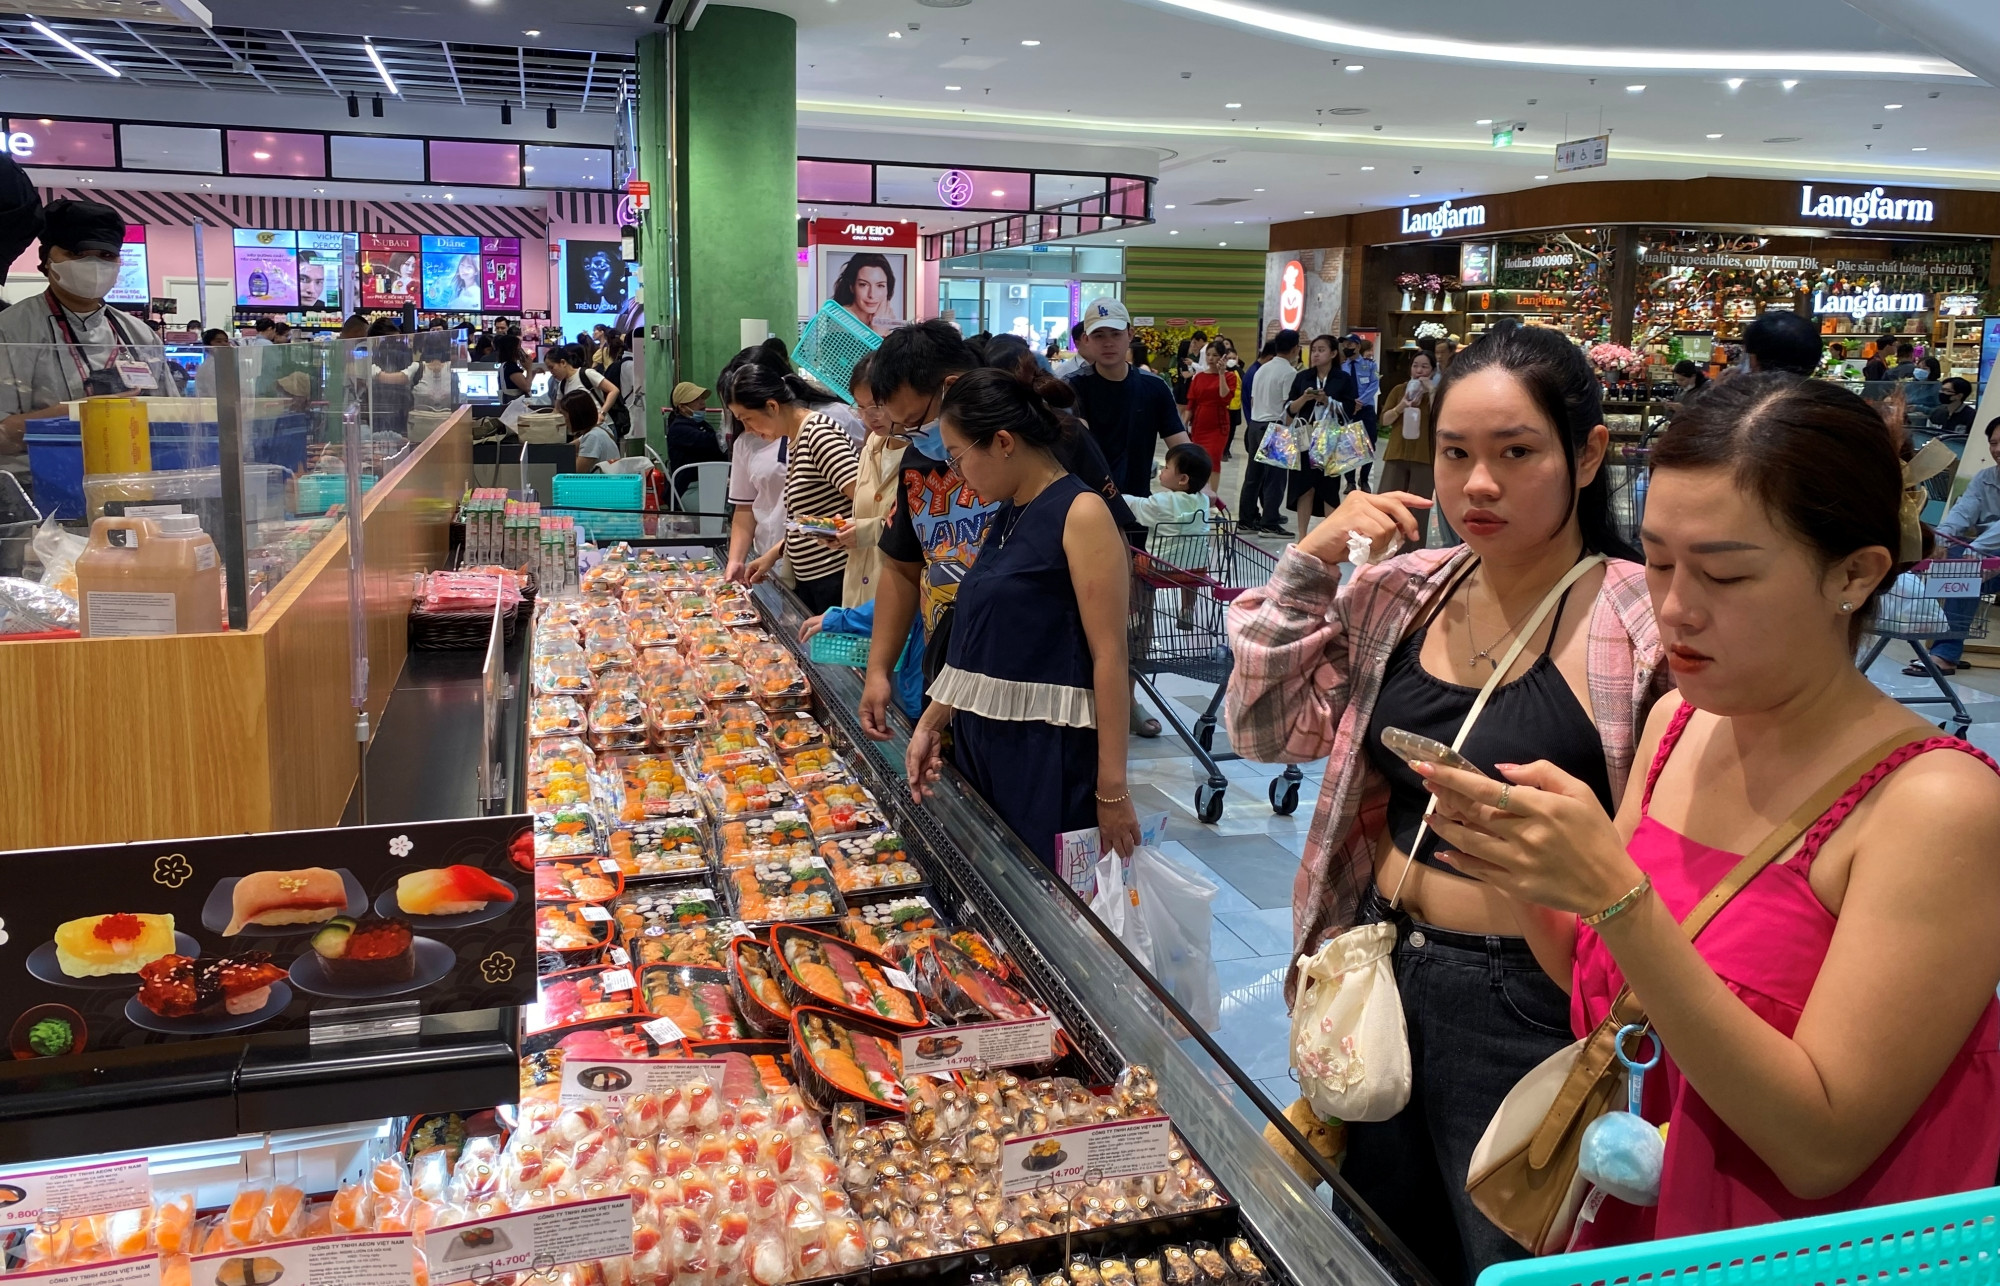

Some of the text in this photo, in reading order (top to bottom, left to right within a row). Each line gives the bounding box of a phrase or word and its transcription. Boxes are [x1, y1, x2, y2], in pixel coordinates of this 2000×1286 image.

[1801, 185, 1933, 226] Langfarm
[1401, 200, 1485, 237] Langfarm
[841, 223, 894, 236] SHISEIDO
[372, 239, 409, 247] TSUBAKI
[1504, 254, 1573, 268] Hotline 19009065
[1637, 252, 1818, 269] Quality specialties, only from 19k
[1836, 260, 1856, 273] Đặc
[1857, 261, 1874, 272] sản
[1876, 260, 1897, 273] chất
[1900, 261, 1928, 275] lượng,
[1946, 263, 1957, 274] từ
[1959, 263, 1974, 275] 19k
[574, 302, 592, 310] TRÊN
[1814, 286, 1925, 319] Langfarm
[1098, 305, 1108, 317] LA
